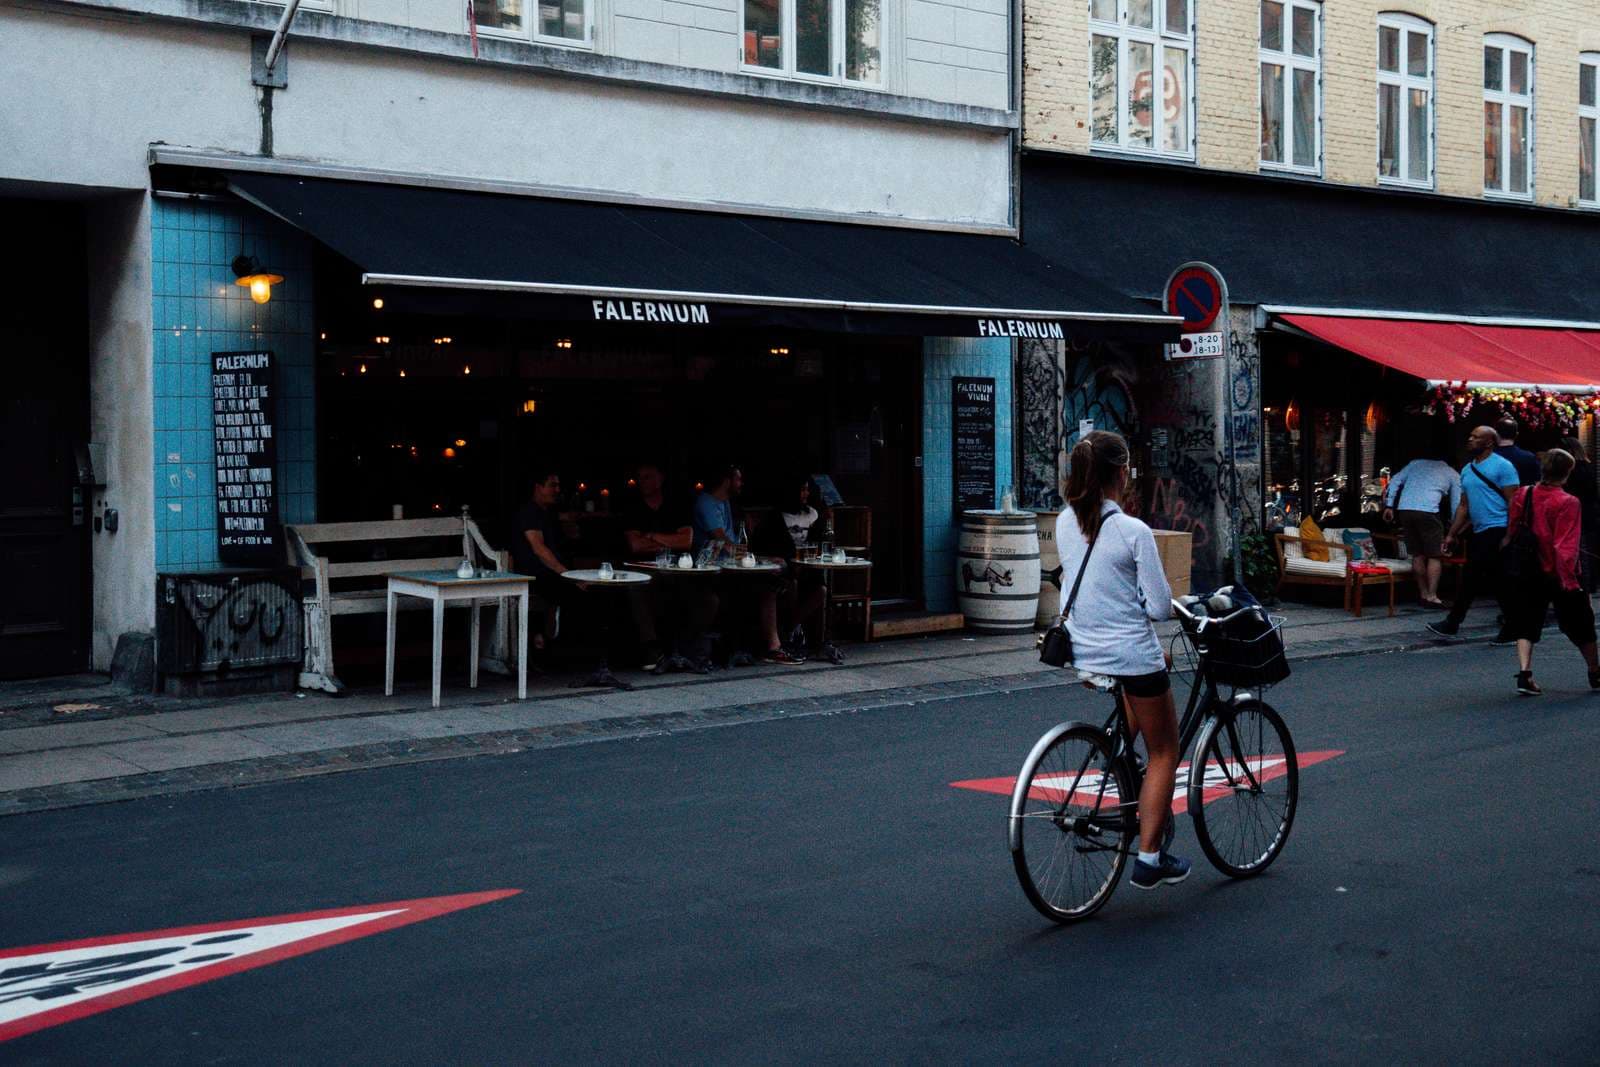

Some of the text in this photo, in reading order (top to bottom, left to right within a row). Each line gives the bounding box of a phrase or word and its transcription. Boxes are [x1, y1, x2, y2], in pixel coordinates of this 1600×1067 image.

[592, 300, 710, 324] FALERNUM
[977, 319, 1064, 339] FALERNUM
[1198, 334, 1219, 344] 8-20
[215, 353, 269, 370] FALERNUM
[957, 383, 993, 393] FALERNUM
